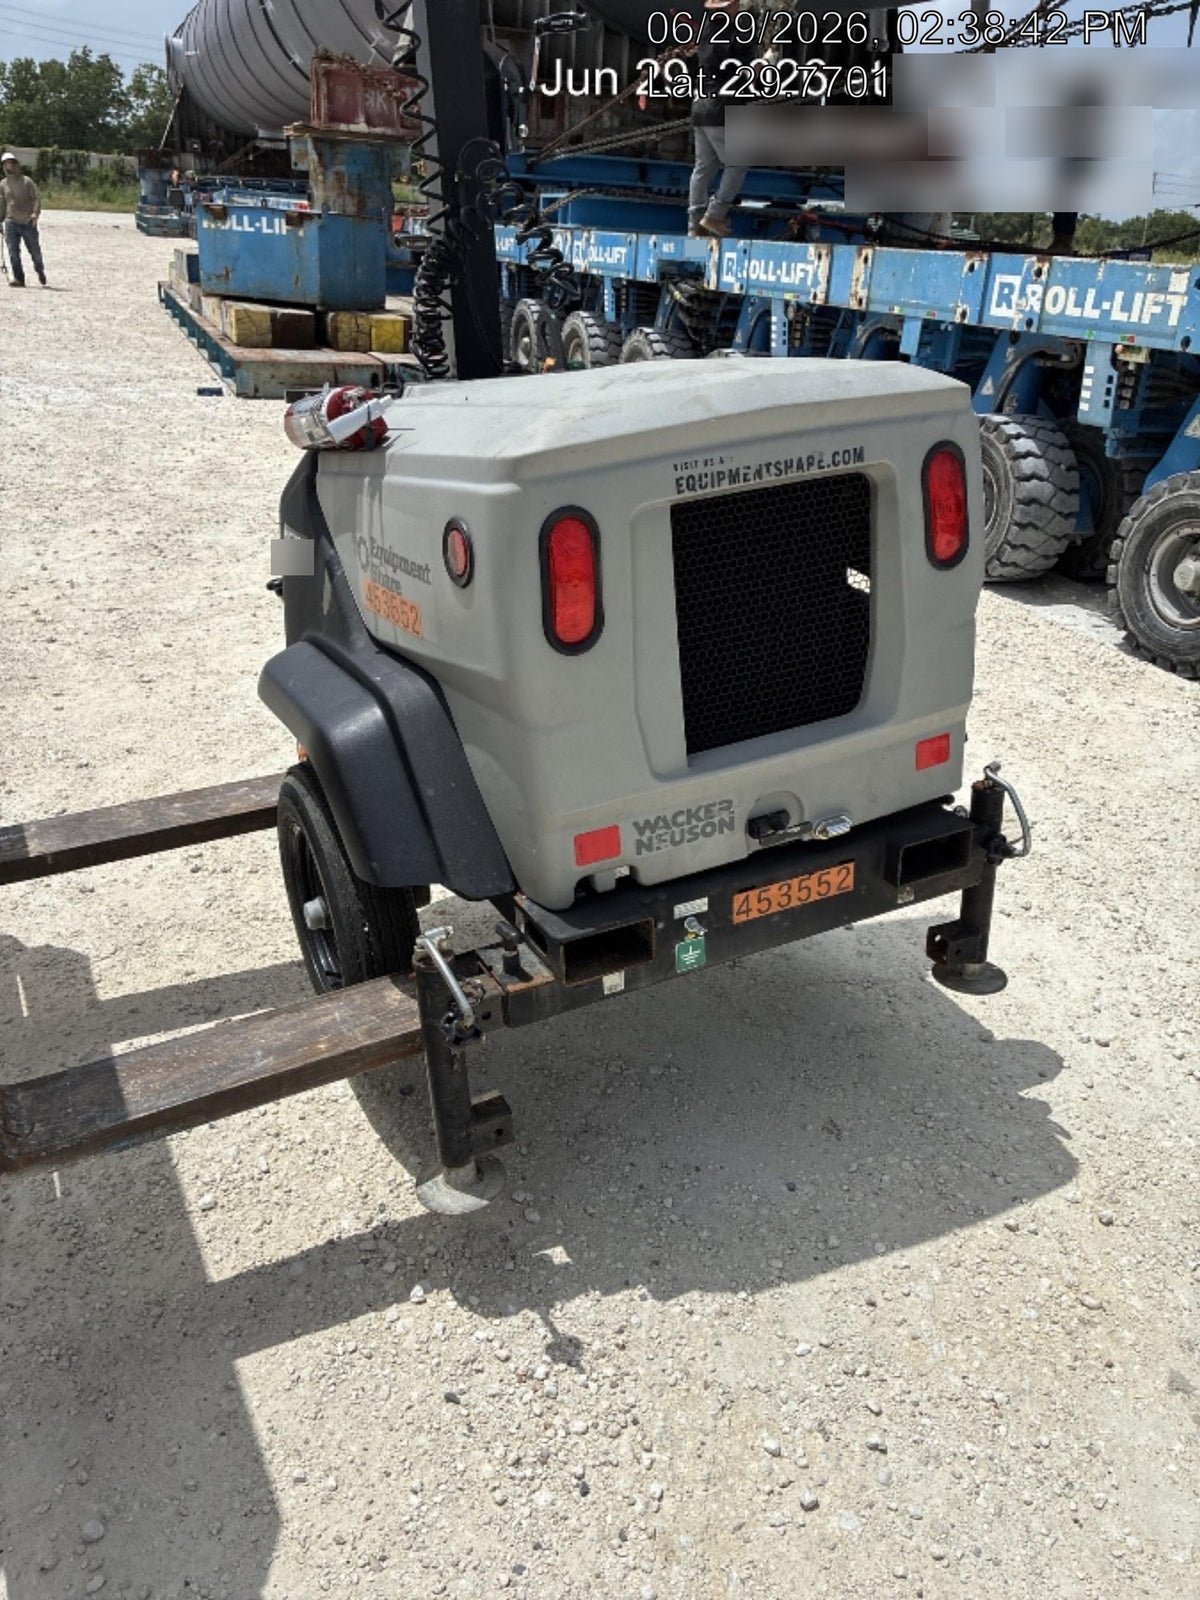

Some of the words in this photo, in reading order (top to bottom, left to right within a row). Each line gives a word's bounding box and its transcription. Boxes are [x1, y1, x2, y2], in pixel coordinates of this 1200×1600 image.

[1022, 283, 1188, 327] ROLL-LIFT
[632, 799, 734, 837] WACKER
[635, 816, 735, 856] NEUSON
[736, 865, 851, 918] 453552
